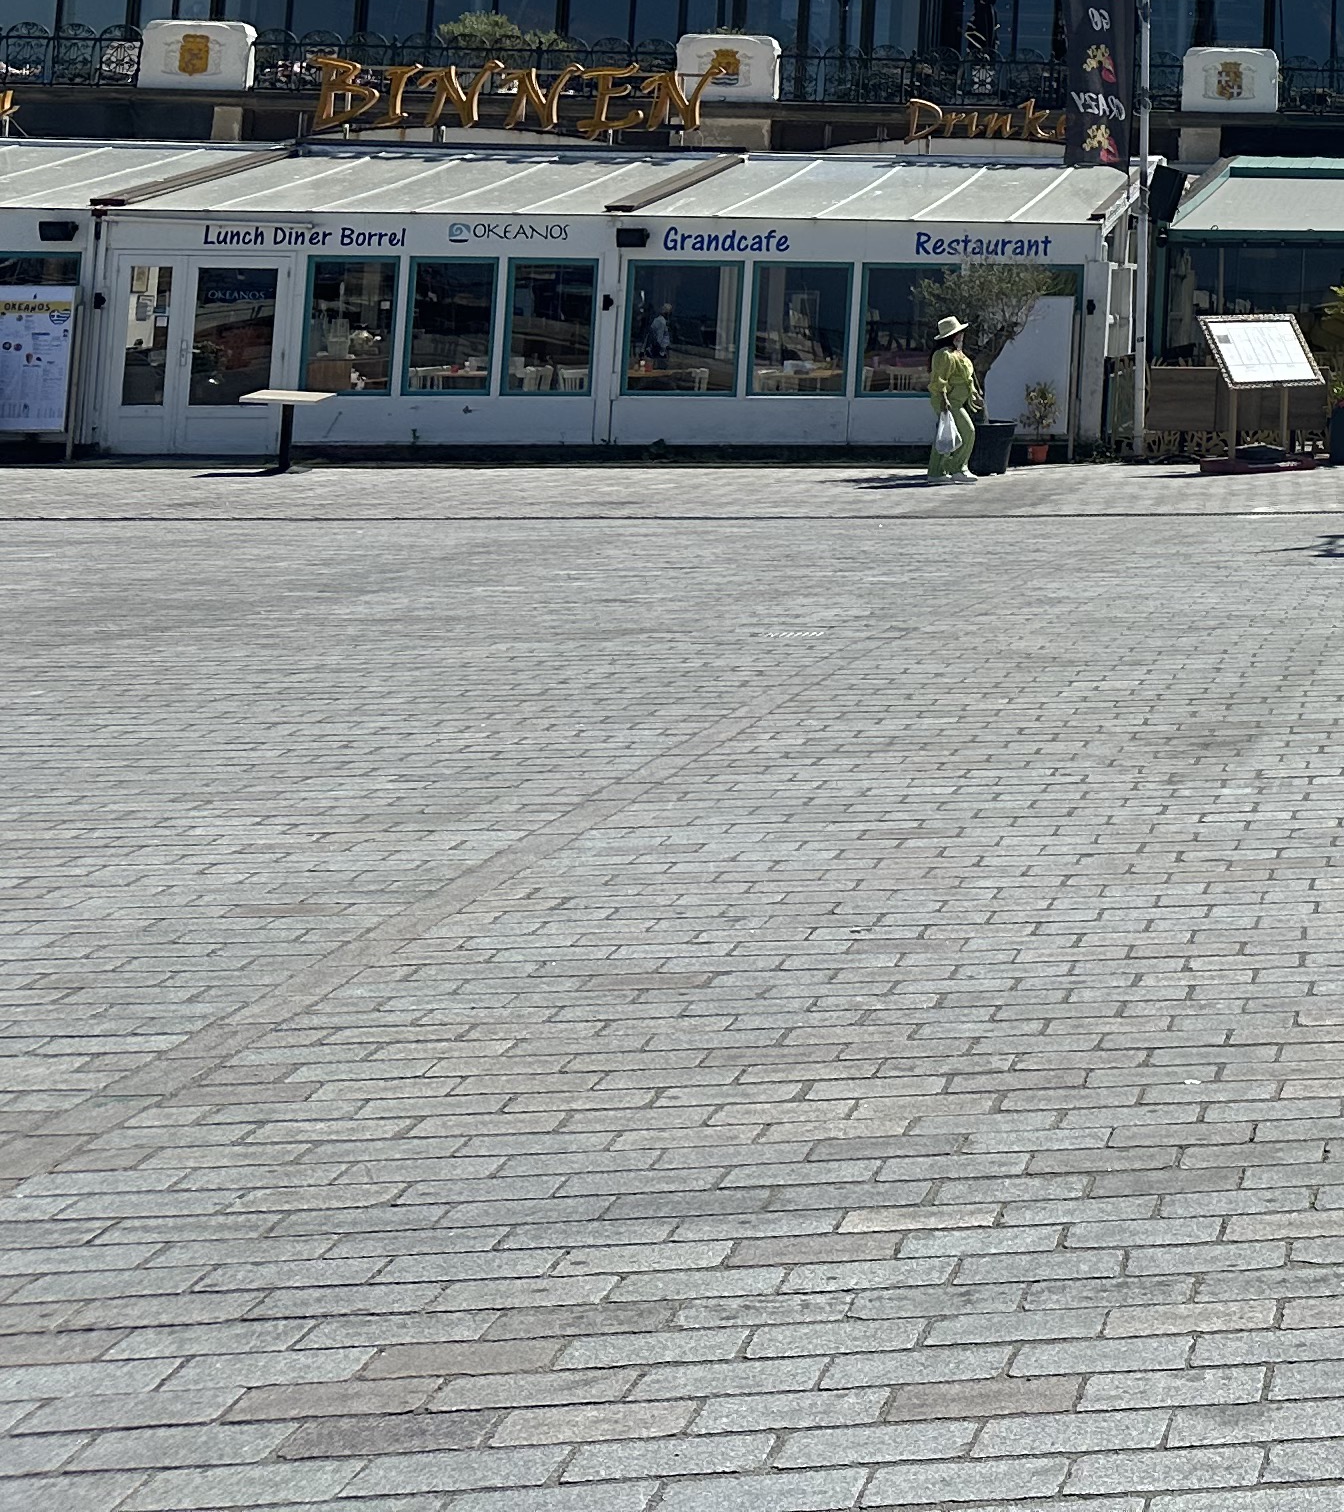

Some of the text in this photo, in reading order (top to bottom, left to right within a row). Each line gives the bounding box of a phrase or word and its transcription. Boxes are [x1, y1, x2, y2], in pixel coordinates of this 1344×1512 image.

[310, 58, 727, 140] BINNEN
[203, 225, 406, 247] Lunch Diner Borrel
[473, 223, 570, 240] OKEANOS
[663, 227, 791, 252] Grandcafe
[915, 232, 1052, 256] Restaurant
[208, 290, 265, 300] OKEANOS
[4, 302, 51, 313] OKEANOS
